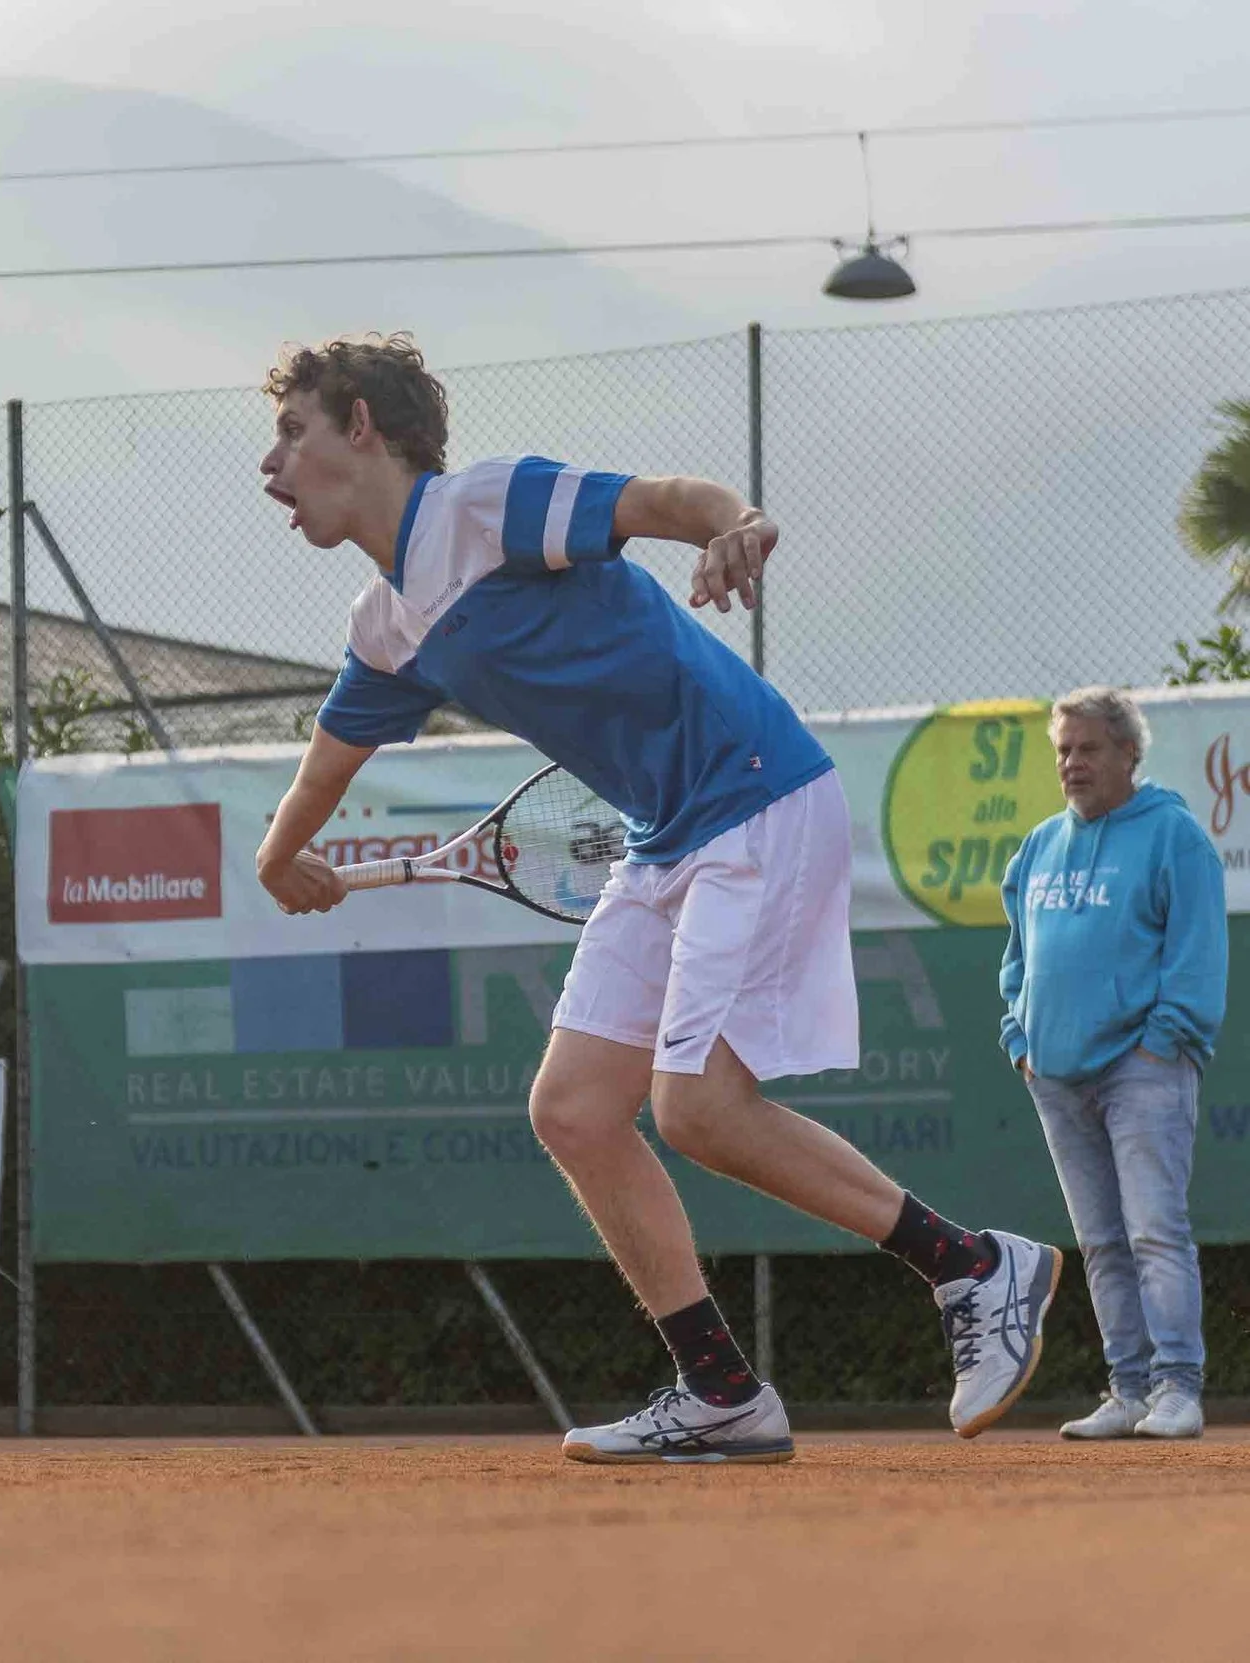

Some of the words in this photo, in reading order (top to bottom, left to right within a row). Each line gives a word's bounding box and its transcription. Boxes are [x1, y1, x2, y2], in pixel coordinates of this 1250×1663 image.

[87, 873, 206, 903] Mobiliare
[920, 836, 1024, 903] spo
[126, 1069, 221, 1105] REAL
[242, 1064, 386, 1101] ESTATE
[404, 1061, 537, 1097] VALUA
